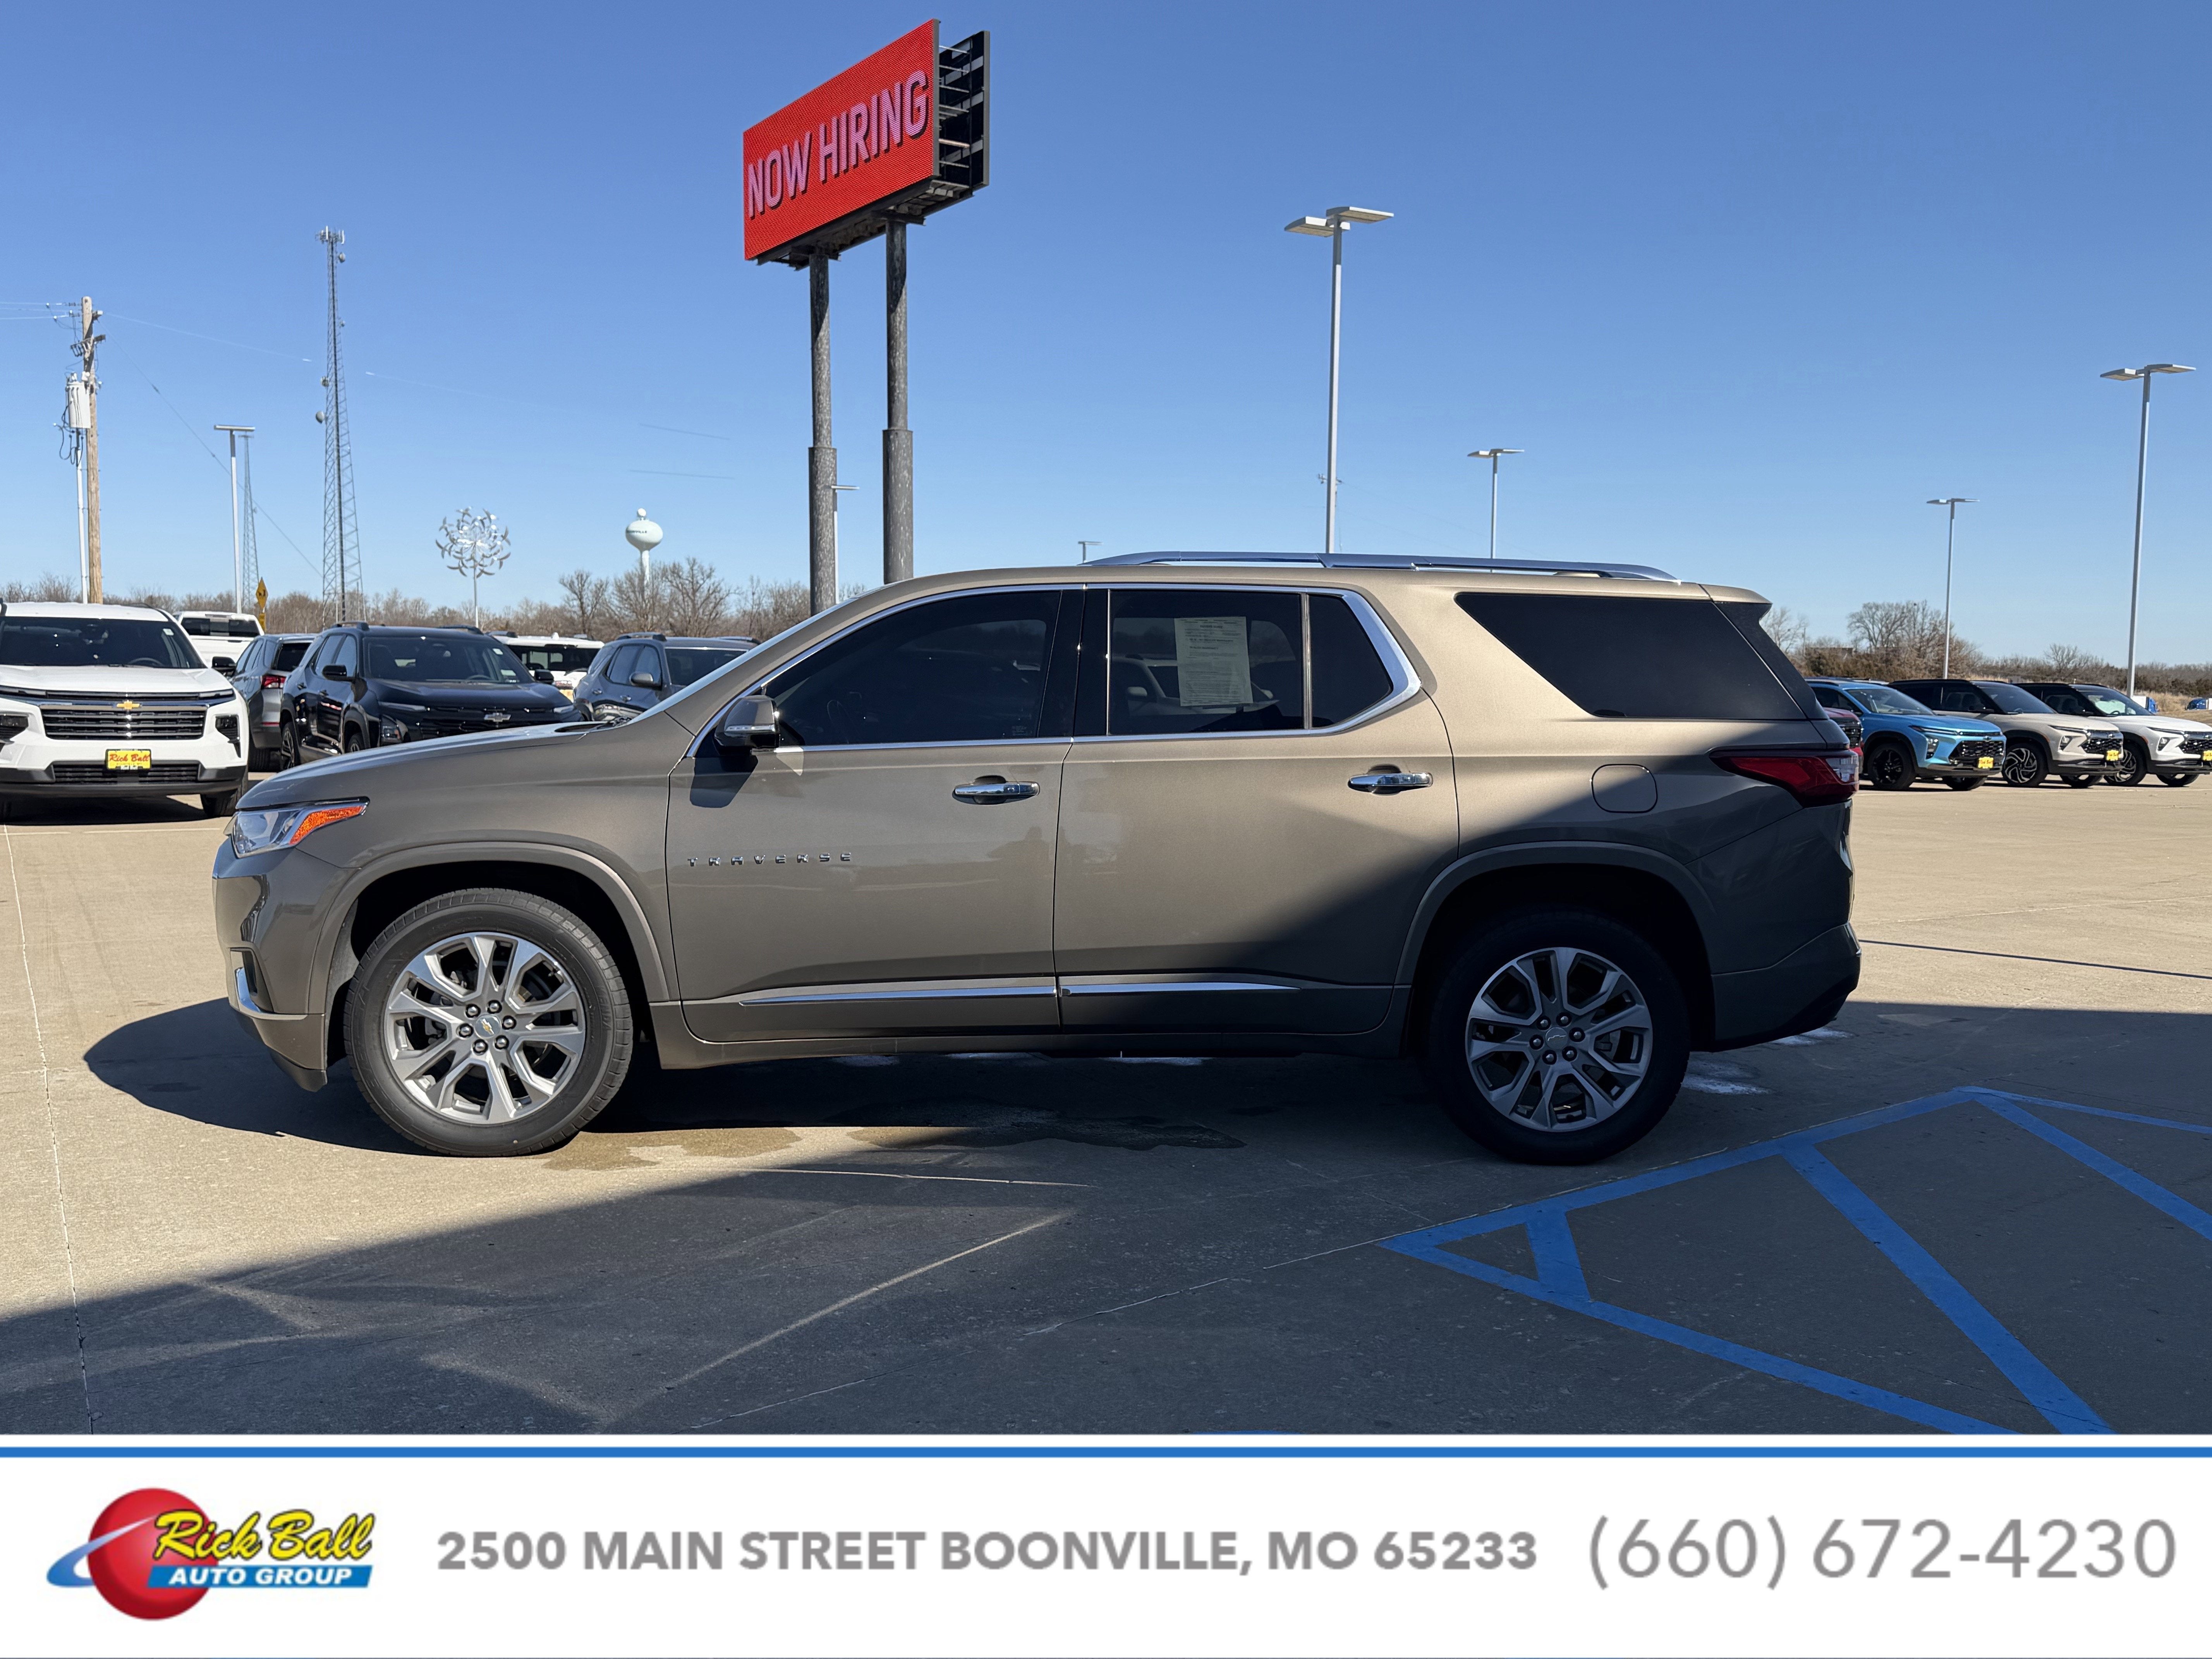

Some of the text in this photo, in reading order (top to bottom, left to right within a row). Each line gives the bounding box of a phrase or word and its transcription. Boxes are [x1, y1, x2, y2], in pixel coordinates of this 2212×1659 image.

[748, 70, 928, 218] NOW HIRING
[688, 852, 851, 867] TRAVERSE
